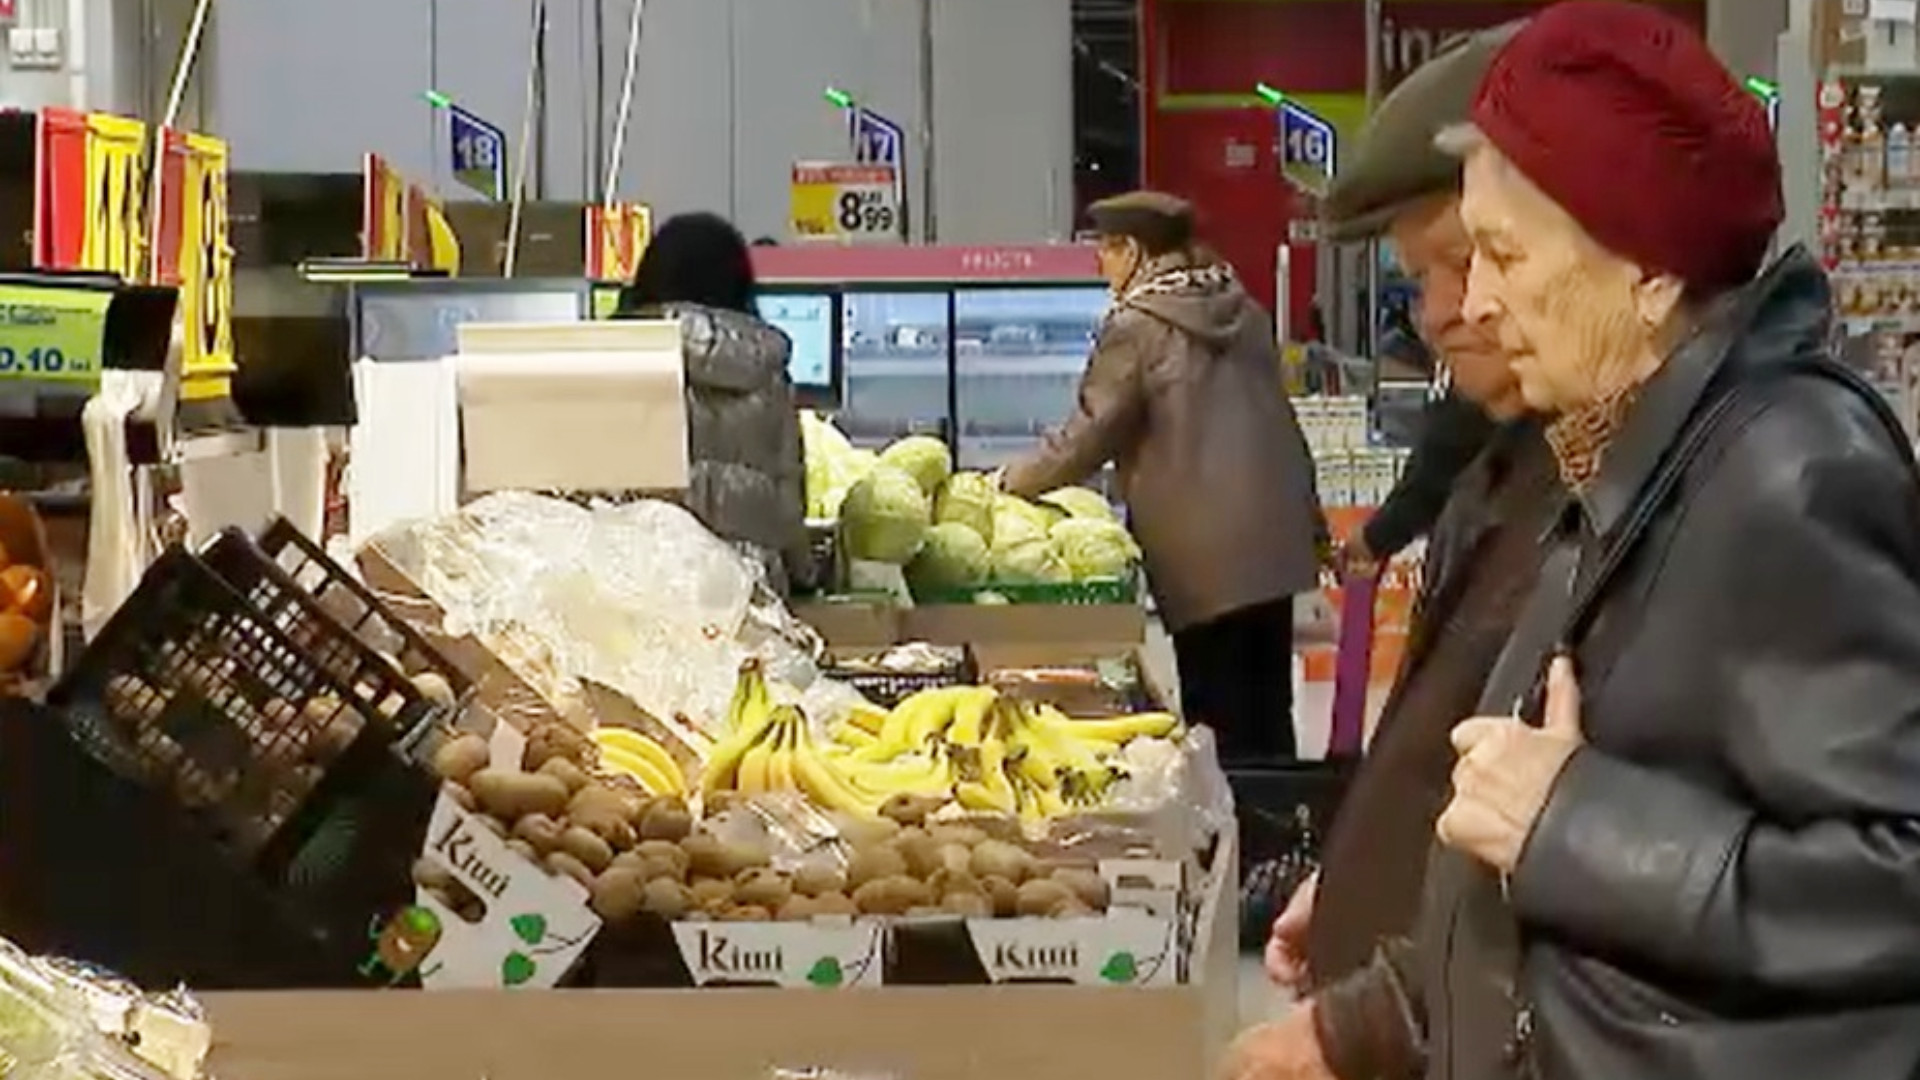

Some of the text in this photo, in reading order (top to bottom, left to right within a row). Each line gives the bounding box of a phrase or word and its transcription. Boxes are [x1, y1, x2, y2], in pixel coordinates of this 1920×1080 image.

[456, 134, 494, 169] 18
[859, 130, 892, 163] 17
[1287, 128, 1325, 161] 16
[840, 191, 862, 231] 8
[864, 205, 893, 232] 99
